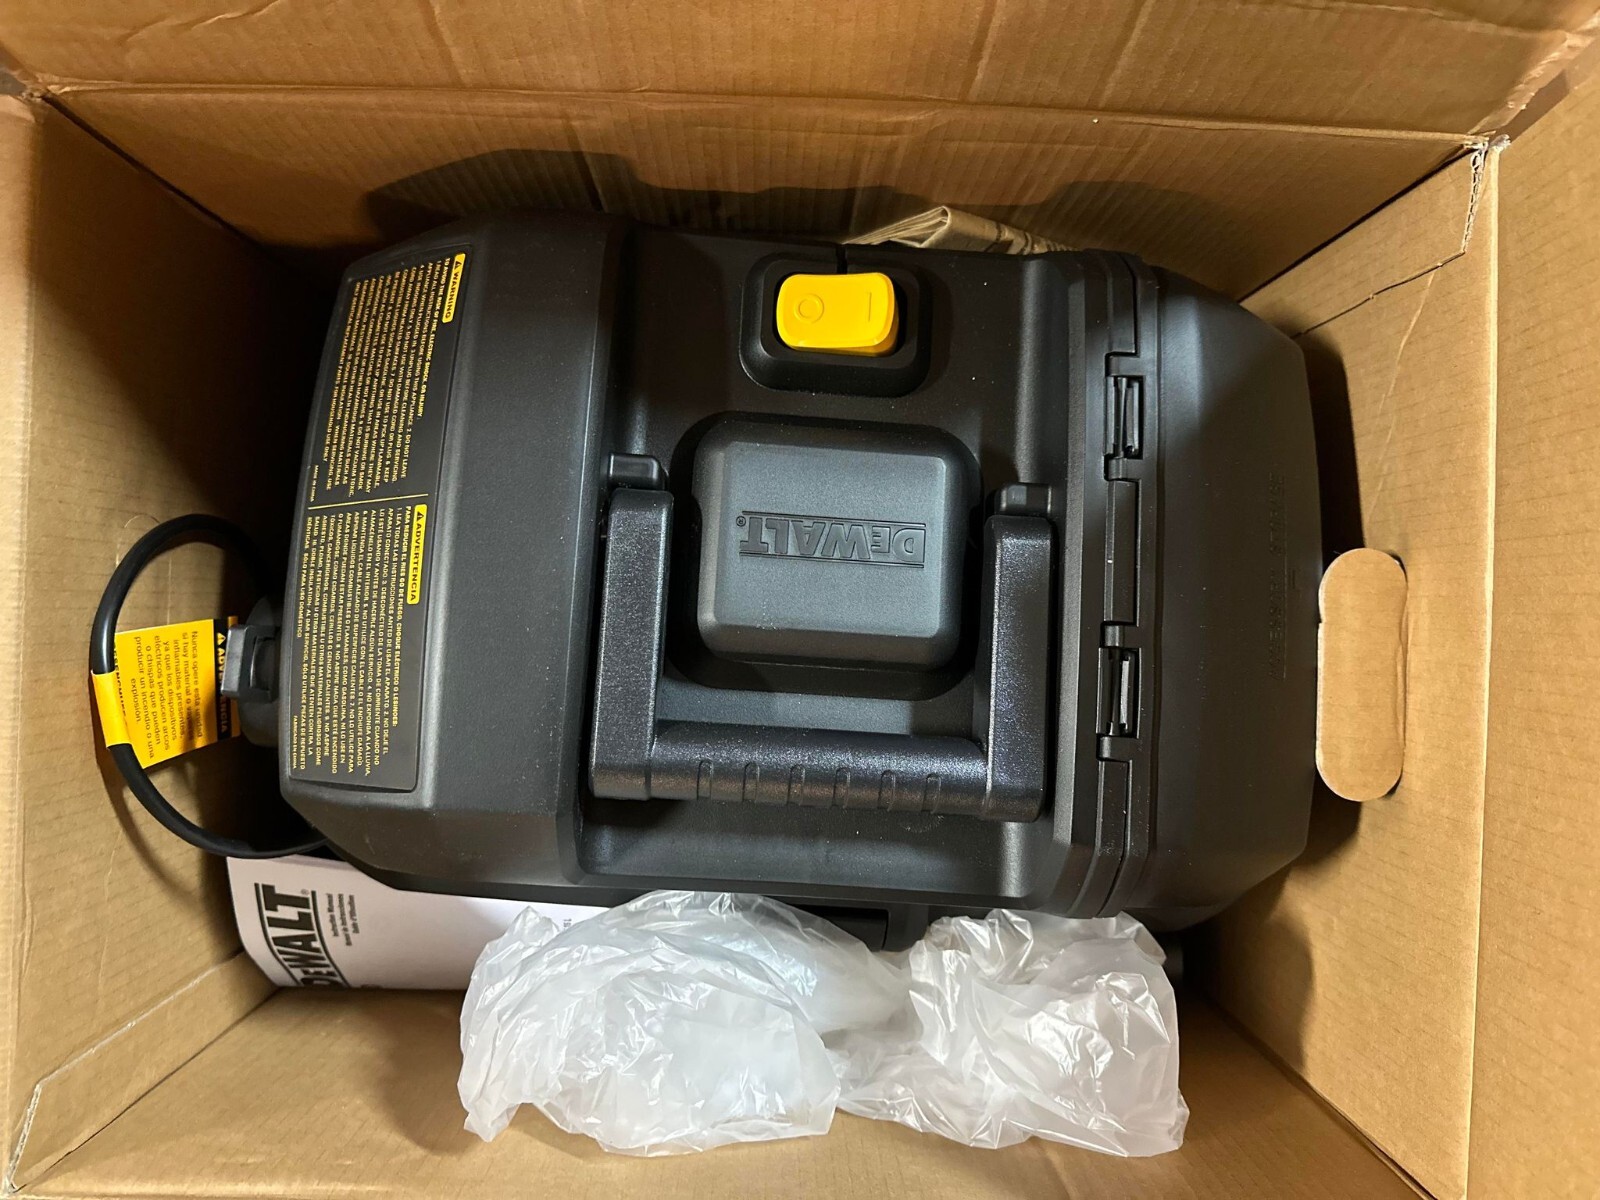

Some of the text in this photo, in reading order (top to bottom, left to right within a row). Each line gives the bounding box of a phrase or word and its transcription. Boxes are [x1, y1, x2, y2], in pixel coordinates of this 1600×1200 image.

[444, 271, 459, 319] WARNING
[739, 517, 927, 563] DEWALT
[409, 522, 422, 601] ADVERTENCIA
[135, 637, 145, 673] producir
[164, 641, 170, 651] ya
[182, 642, 190, 657] hay
[146, 654, 155, 688] chispas
[166, 673, 174, 686] los
[173, 640, 182, 690] inflamables
[184, 661, 192, 696] material
[192, 661, 200, 685] opere
[140, 678, 146, 688] un
[149, 692, 157, 708] que
[141, 692, 152, 730] incendio
[157, 682, 167, 723] producen
[167, 689, 177, 740] dispositivos
[152, 712, 160, 744] pueden
[195, 709, 203, 738] unidad
